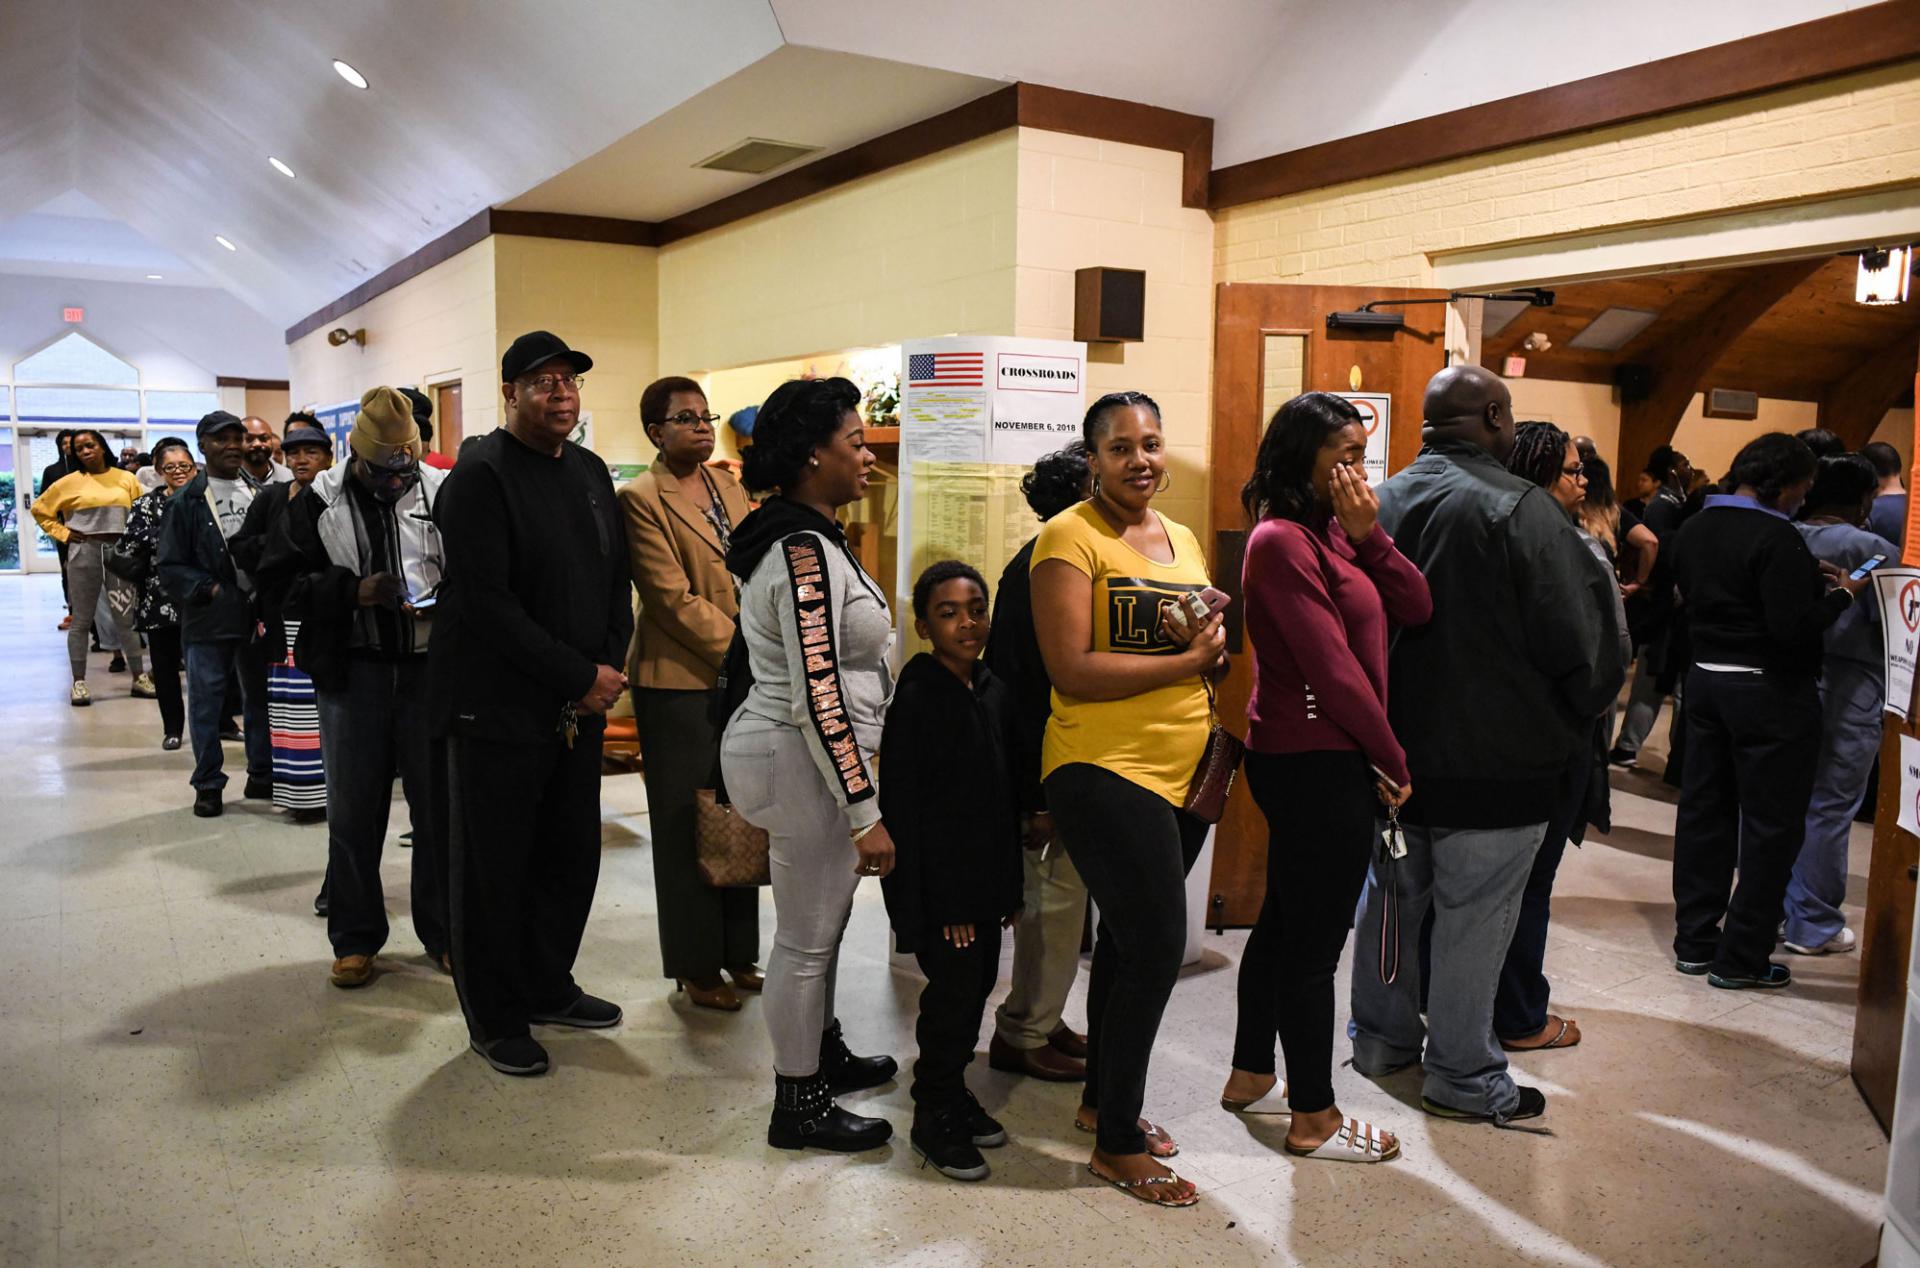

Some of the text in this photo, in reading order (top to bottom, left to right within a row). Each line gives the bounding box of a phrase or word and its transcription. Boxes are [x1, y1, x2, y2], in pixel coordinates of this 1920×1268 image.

[1001, 367, 1076, 380] CROSSROADS
[995, 421, 1076, 432] NOVEMBER 6, 2018
[788, 545, 824, 602] PINK
[799, 605, 833, 673] PINK
[808, 672, 849, 736] PINK
[828, 732, 869, 794] PINK
